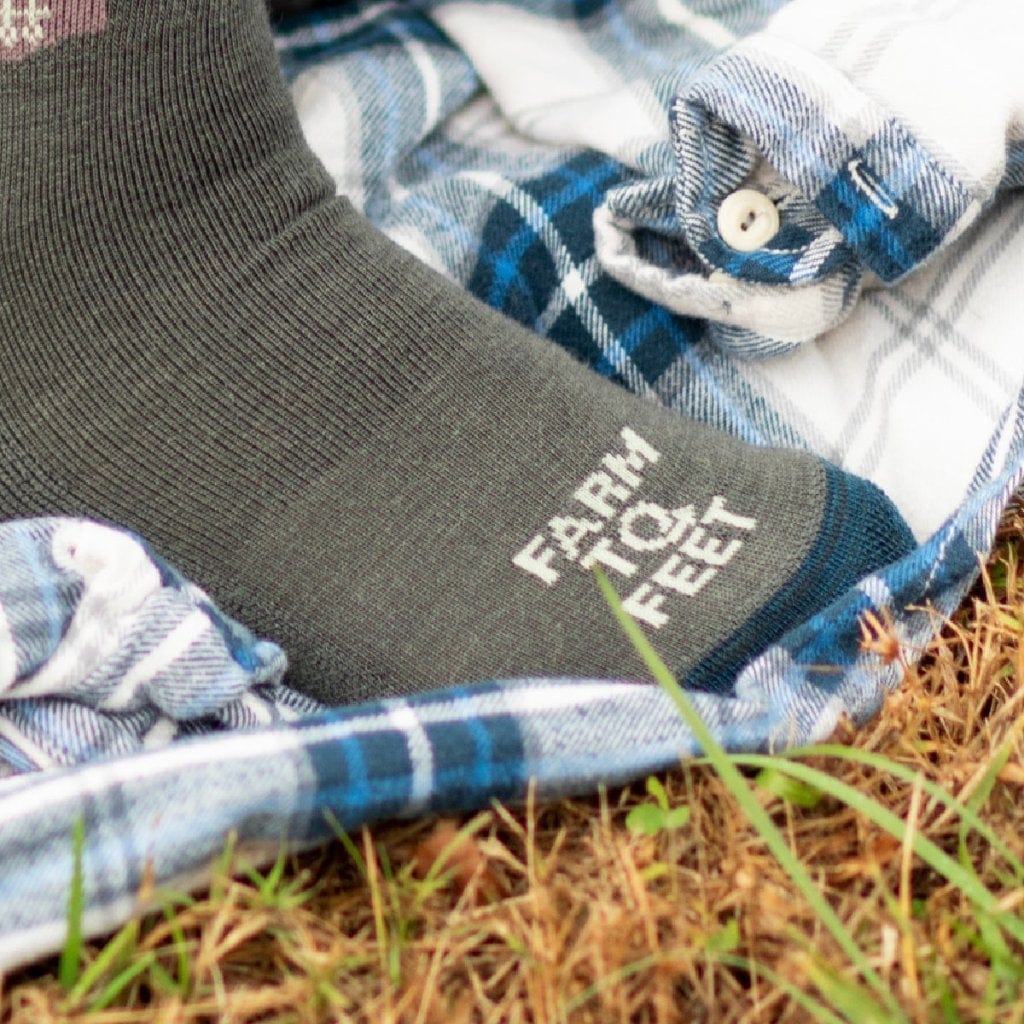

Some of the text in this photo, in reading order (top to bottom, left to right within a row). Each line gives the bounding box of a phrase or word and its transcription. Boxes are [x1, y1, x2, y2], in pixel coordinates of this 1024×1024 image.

[512, 426, 661, 587] FARM
[580, 500, 690, 577] TO
[621, 494, 757, 628] FEET
